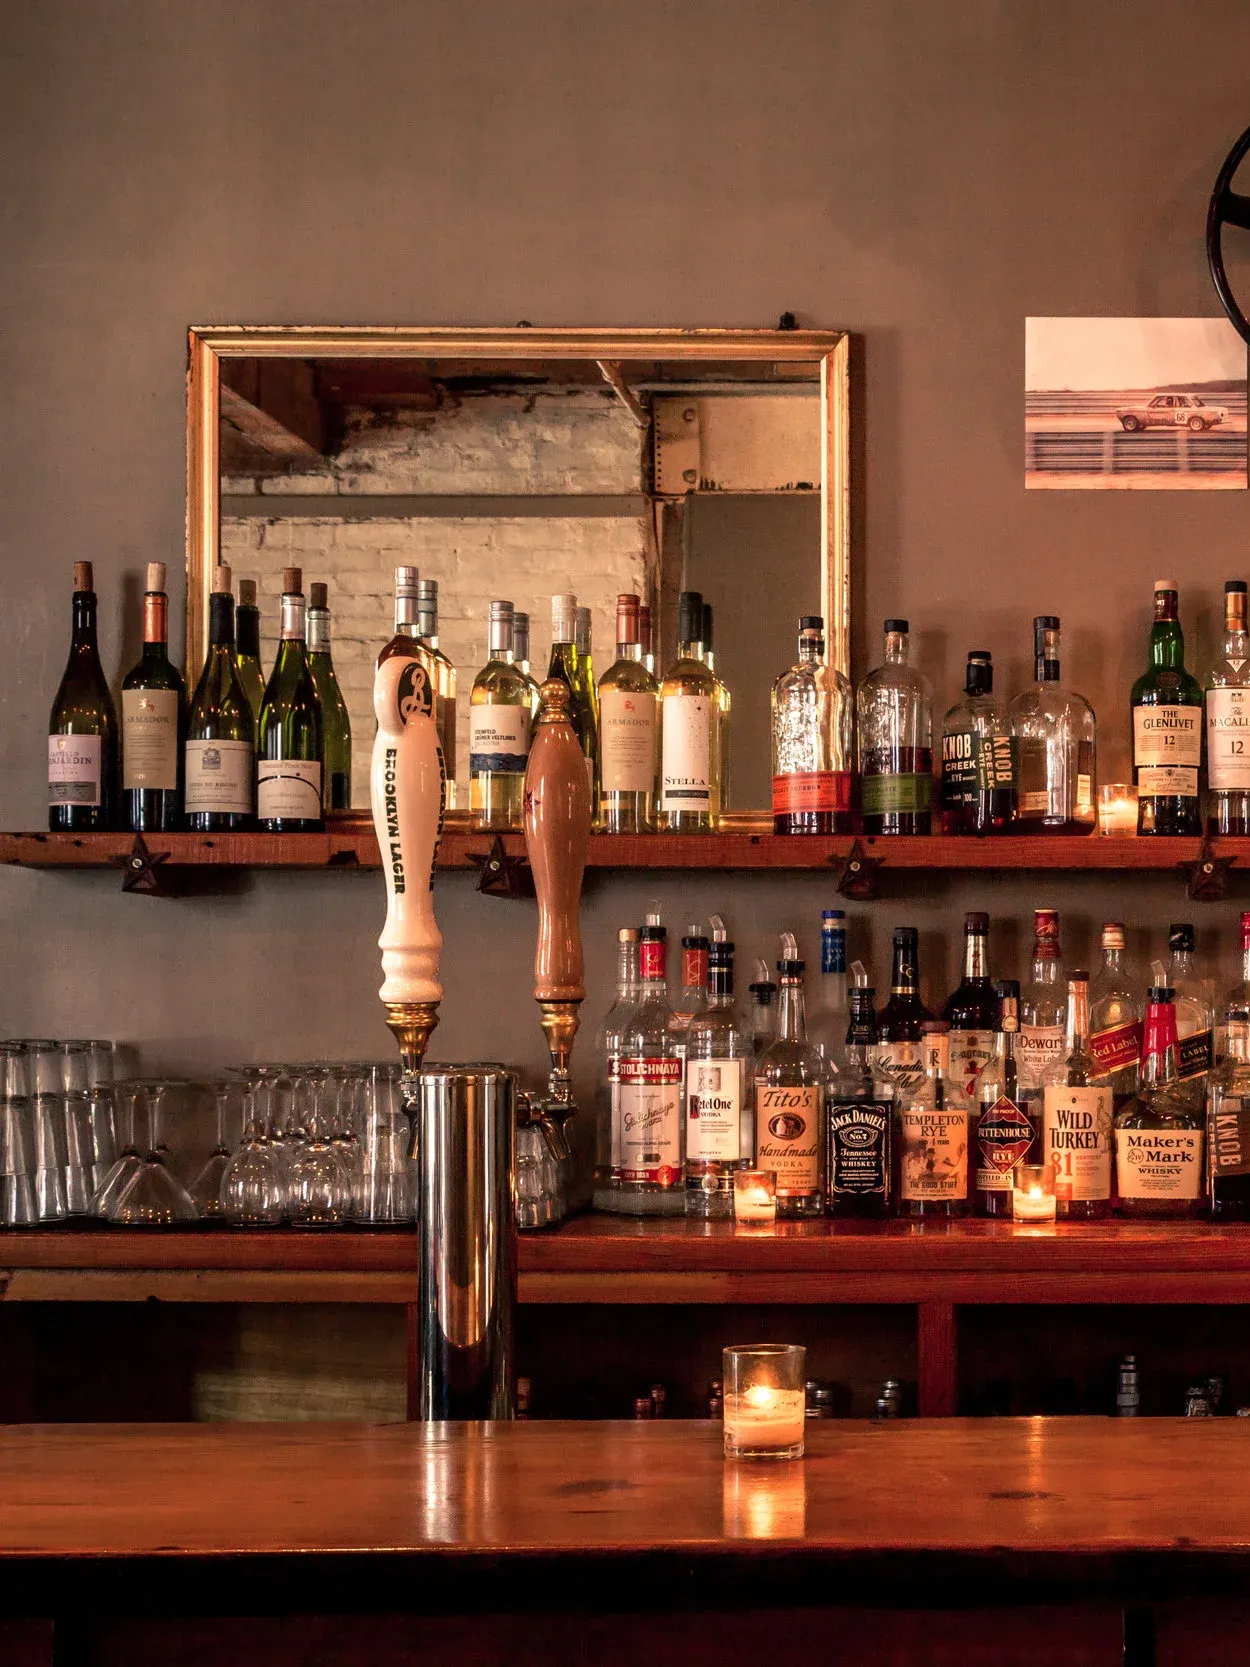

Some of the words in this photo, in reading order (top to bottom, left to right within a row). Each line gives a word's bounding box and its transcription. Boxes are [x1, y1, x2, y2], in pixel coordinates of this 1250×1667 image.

[1161, 710, 1178, 718] THE
[1229, 706, 1243, 717] The
[608, 718, 650, 726] ARMADOR
[1143, 718, 1195, 730] GLENLIVET
[1164, 735, 1176, 745] 12
[942, 733, 972, 761] KNOB
[1231, 740, 1244, 754] 12
[49, 757, 92, 765] NJARDIN
[945, 759, 977, 772] CREEK
[984, 742, 995, 789] CREEK
[993, 736, 1013, 782] KNOB
[664, 776, 706, 786] STELLA
[384, 748, 400, 838] BROOKLYN
[390, 842, 406, 895] LAGER
[1111, 1037, 1138, 1051] Label
[1023, 1055, 1042, 1063] White
[620, 1063, 680, 1075] STOLICHNAYA
[713, 1097, 732, 1110] One
[763, 1089, 812, 1108] Tito's
[830, 1113, 853, 1131] JACK
[852, 1109, 887, 1131] DANIEL'S
[904, 1115, 964, 1125] TEMPLETON
[1056, 1110, 1092, 1129] WILD
[921, 1126, 947, 1137] RYE
[978, 1127, 1030, 1138] RITTENHOUSE
[1049, 1128, 1099, 1150] TURKEY
[1127, 1136, 1194, 1148] Maker's
[1216, 1114, 1241, 1166] KNOB
[759, 1143, 817, 1157] Handmade
[840, 1148, 877, 1156] Tennessee
[1209, 1122, 1218, 1175] CREEK
[1146, 1151, 1193, 1162] Mark
[1050, 1151, 1073, 1176] 81
